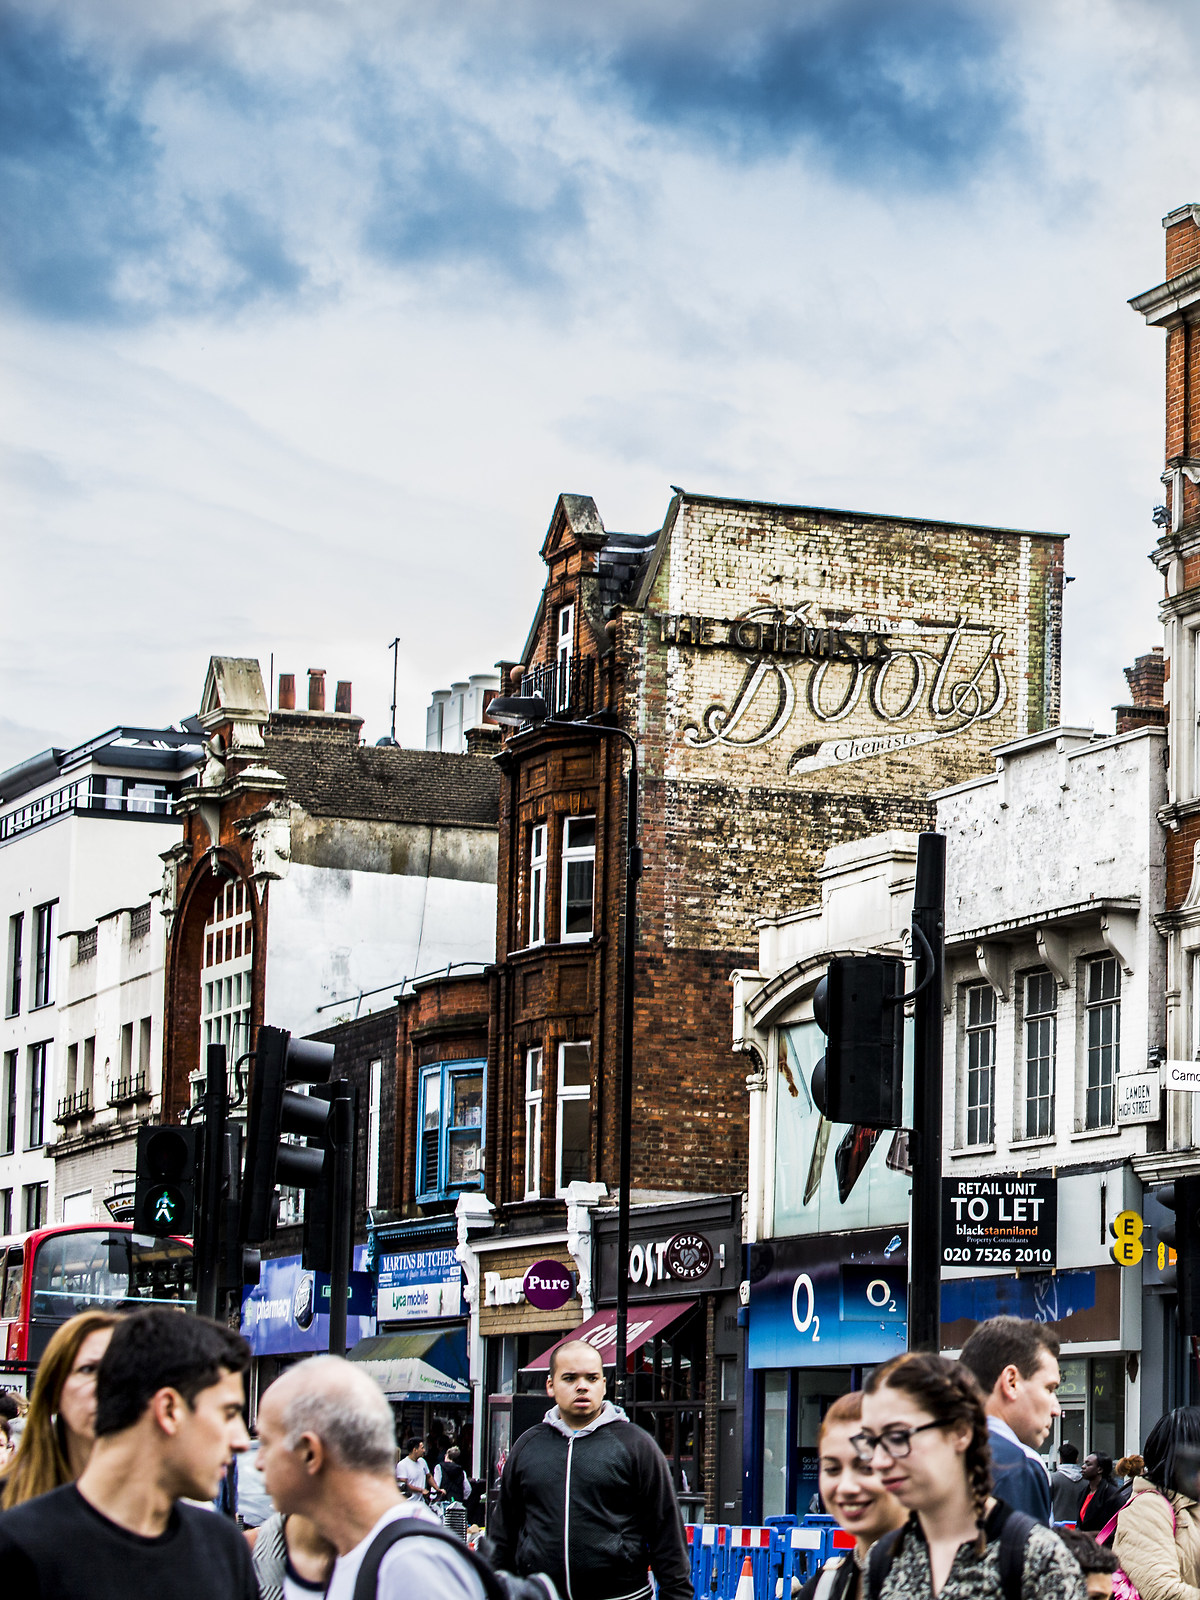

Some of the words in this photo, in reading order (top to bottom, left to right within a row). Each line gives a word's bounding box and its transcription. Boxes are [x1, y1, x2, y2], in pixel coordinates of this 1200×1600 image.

[864, 616, 901, 632] The
[654, 612, 713, 645] THE
[733, 621, 892, 662] CHEMISTS
[683, 601, 1008, 748] Boots
[834, 732, 918, 763] Chemists
[1125, 1084, 1151, 1100] CAMDEN
[1118, 1103, 1131, 1117] HIGH
[1132, 1100, 1152, 1115] STREET
[958, 1182, 1002, 1195] RETAIL
[1005, 1183, 1037, 1196] UNIT
[950, 1197, 989, 1222] TO
[998, 1197, 1045, 1222] LET
[956, 1223, 1039, 1236] blackstanniland
[673, 1236, 703, 1250] COSTA
[966, 1236, 992, 1245] Property
[992, 1236, 1029, 1244] Consultants
[382, 1253, 417, 1272] MARTINS
[416, 1248, 458, 1269] BUTCHERS
[943, 1247, 972, 1262] 020
[975, 1248, 1012, 1262] 7526
[1014, 1248, 1052, 1262] 2010
[672, 1261, 708, 1277] COFFEE
[528, 1275, 570, 1291] Pure
[256, 1296, 292, 1324] pharmacy
